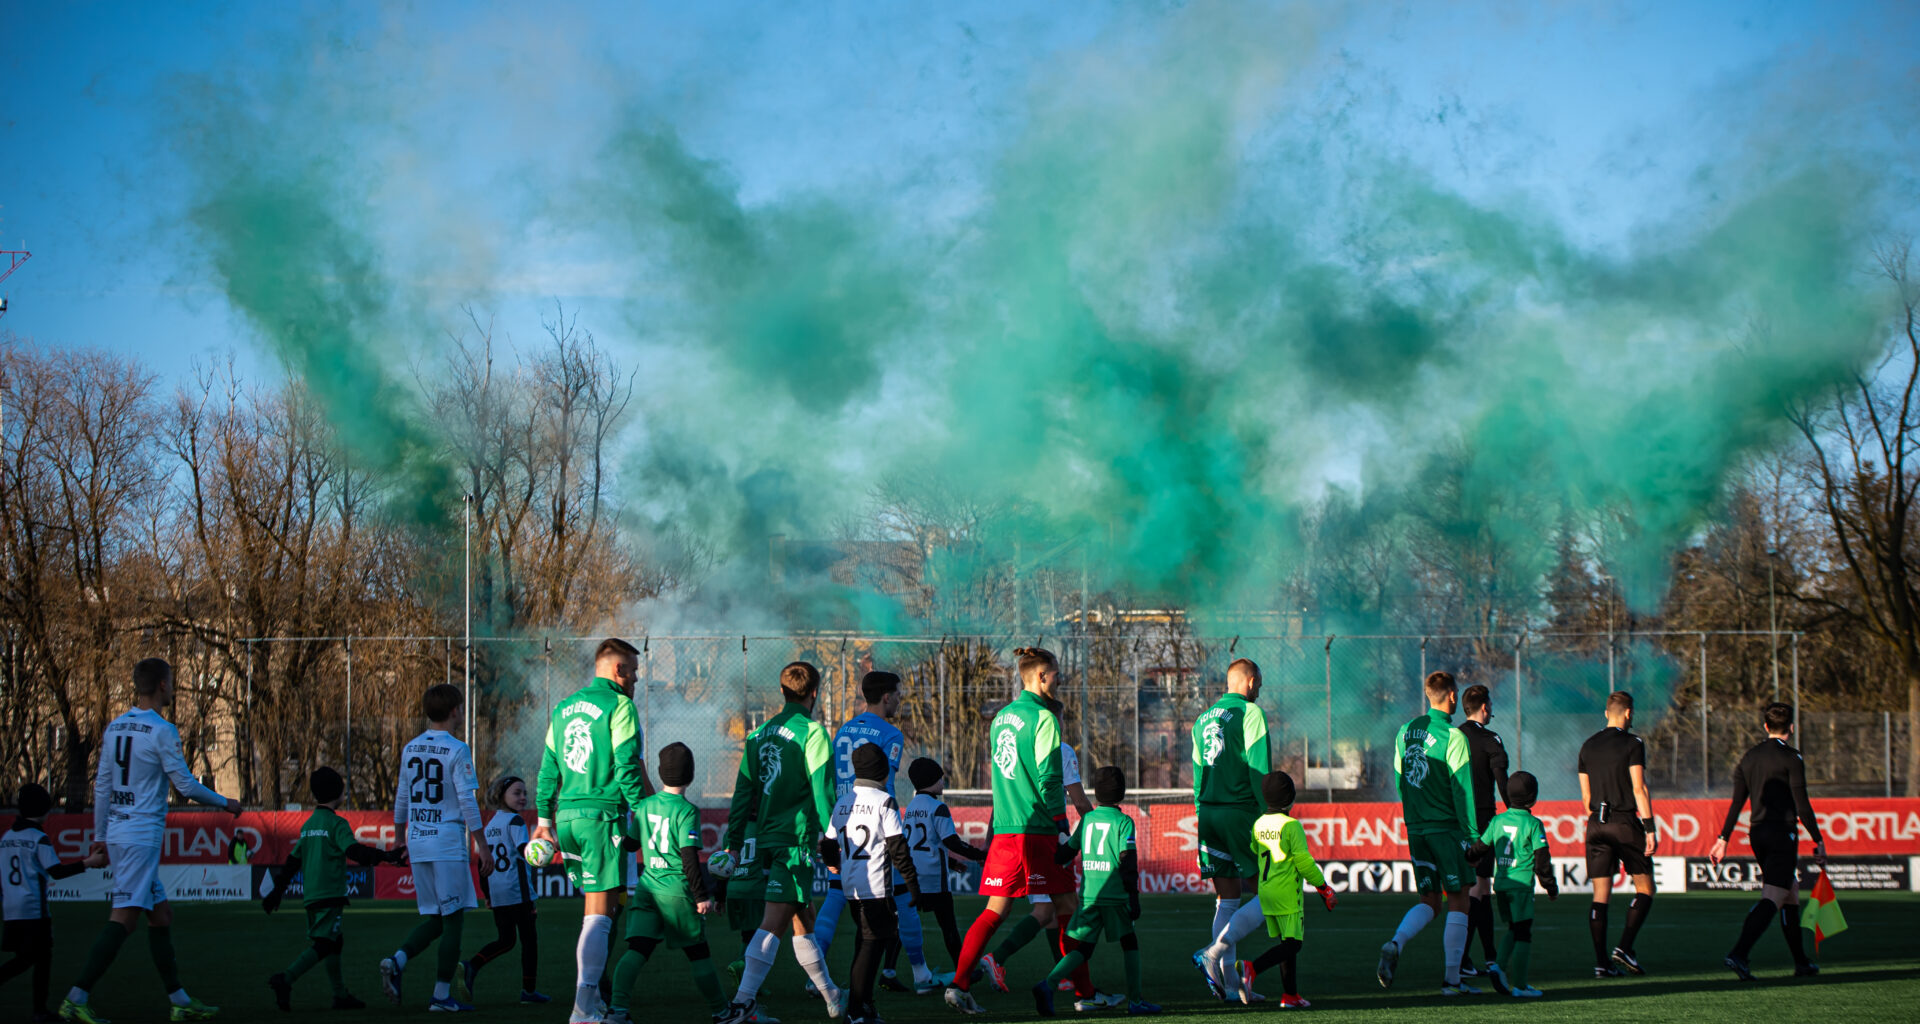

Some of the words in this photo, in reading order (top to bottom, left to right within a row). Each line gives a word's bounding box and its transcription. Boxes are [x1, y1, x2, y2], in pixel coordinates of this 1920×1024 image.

[575, 700, 603, 720] LEVADIA
[1209, 707, 1234, 723] LEVADIA
[1004, 713, 1025, 731] LEVADIA
[767, 725, 796, 742] LEVADIA
[1413, 728, 1438, 747] LEVADIA
[115, 735, 133, 786] 4
[835, 736, 870, 779] 3
[407, 757, 443, 804] 28
[839, 804, 874, 816] ZLATAN
[647, 813, 670, 854] 71
[839, 824, 871, 861] 12
[1084, 822, 1111, 856] 17
[1503, 825, 1518, 855] 7
[9, 854, 22, 886] 8
[1689, 862, 1743, 883] EVG
[984, 876, 1003, 887] Delfi
[176, 889, 201, 897] ELME
[206, 889, 244, 897] METALL
